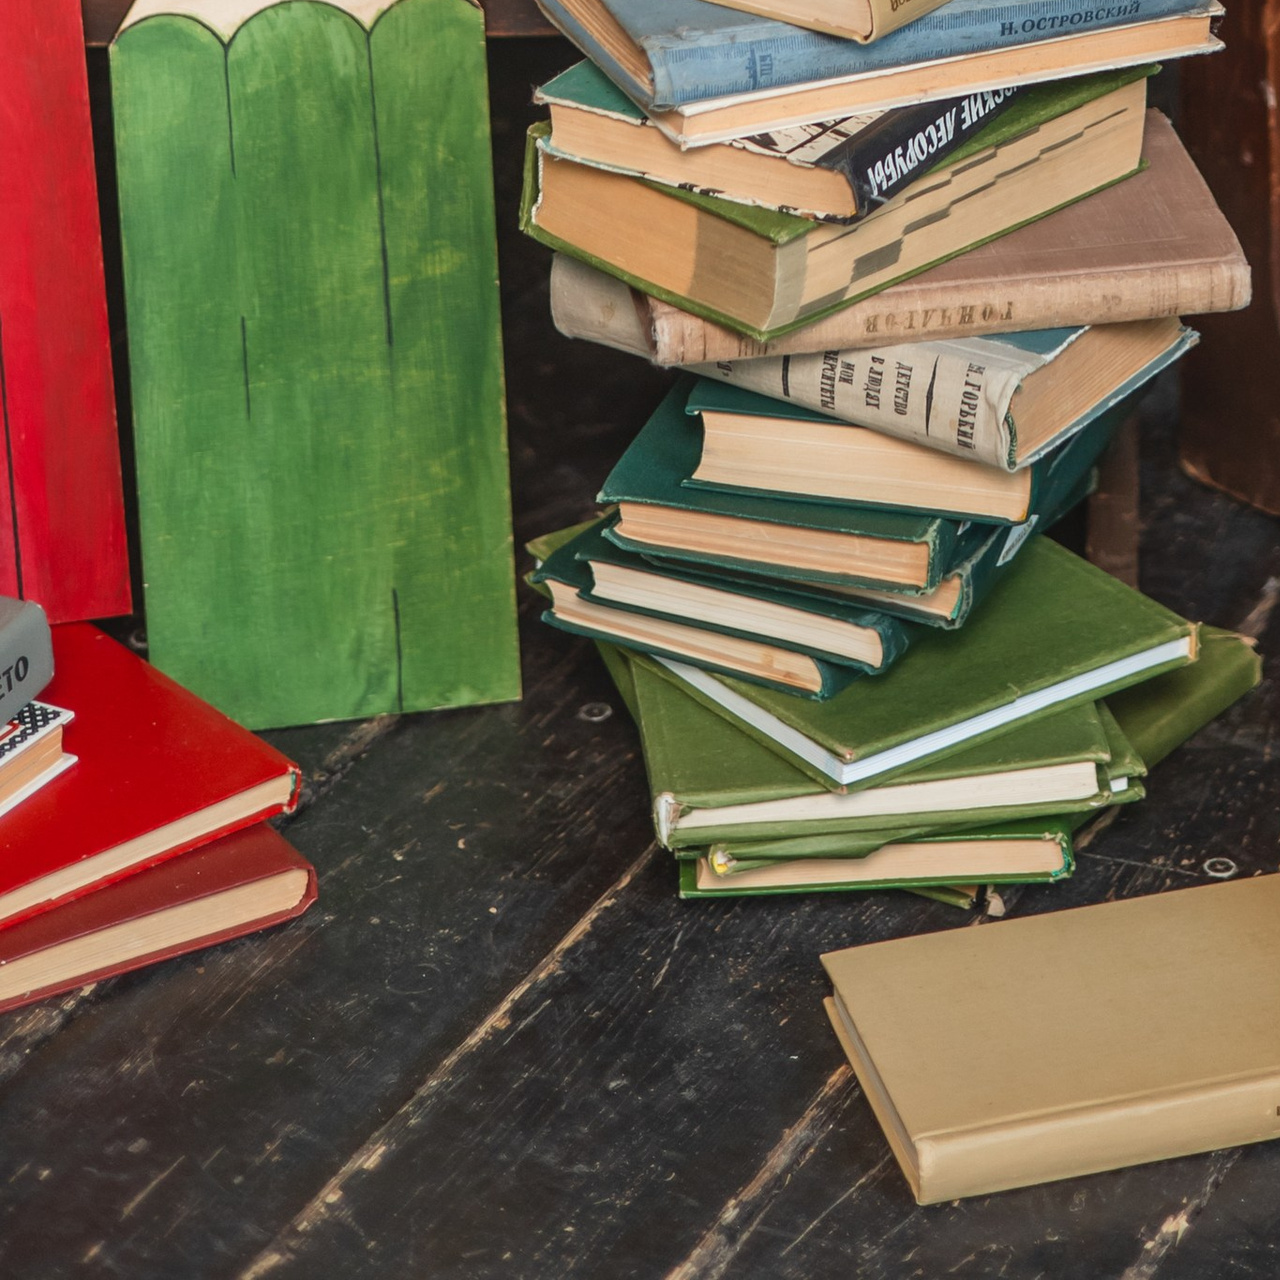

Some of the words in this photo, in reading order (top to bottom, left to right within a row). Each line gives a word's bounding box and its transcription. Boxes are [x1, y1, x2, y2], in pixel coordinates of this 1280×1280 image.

[1021, 0, 1142, 33] ОСТРОВСКИЙ
[866, 106, 958, 197] ЛЕСОРУБЫ
[820, 349, 840, 411] ВЕРСИТЕТЫ
[838, 359, 856, 386] МОИ
[864, 365, 884, 410] ЛЮДЯХ
[894, 361, 913, 417] ДЕТСТВО
[957, 380, 983, 450] ГОРЬКИЙ
